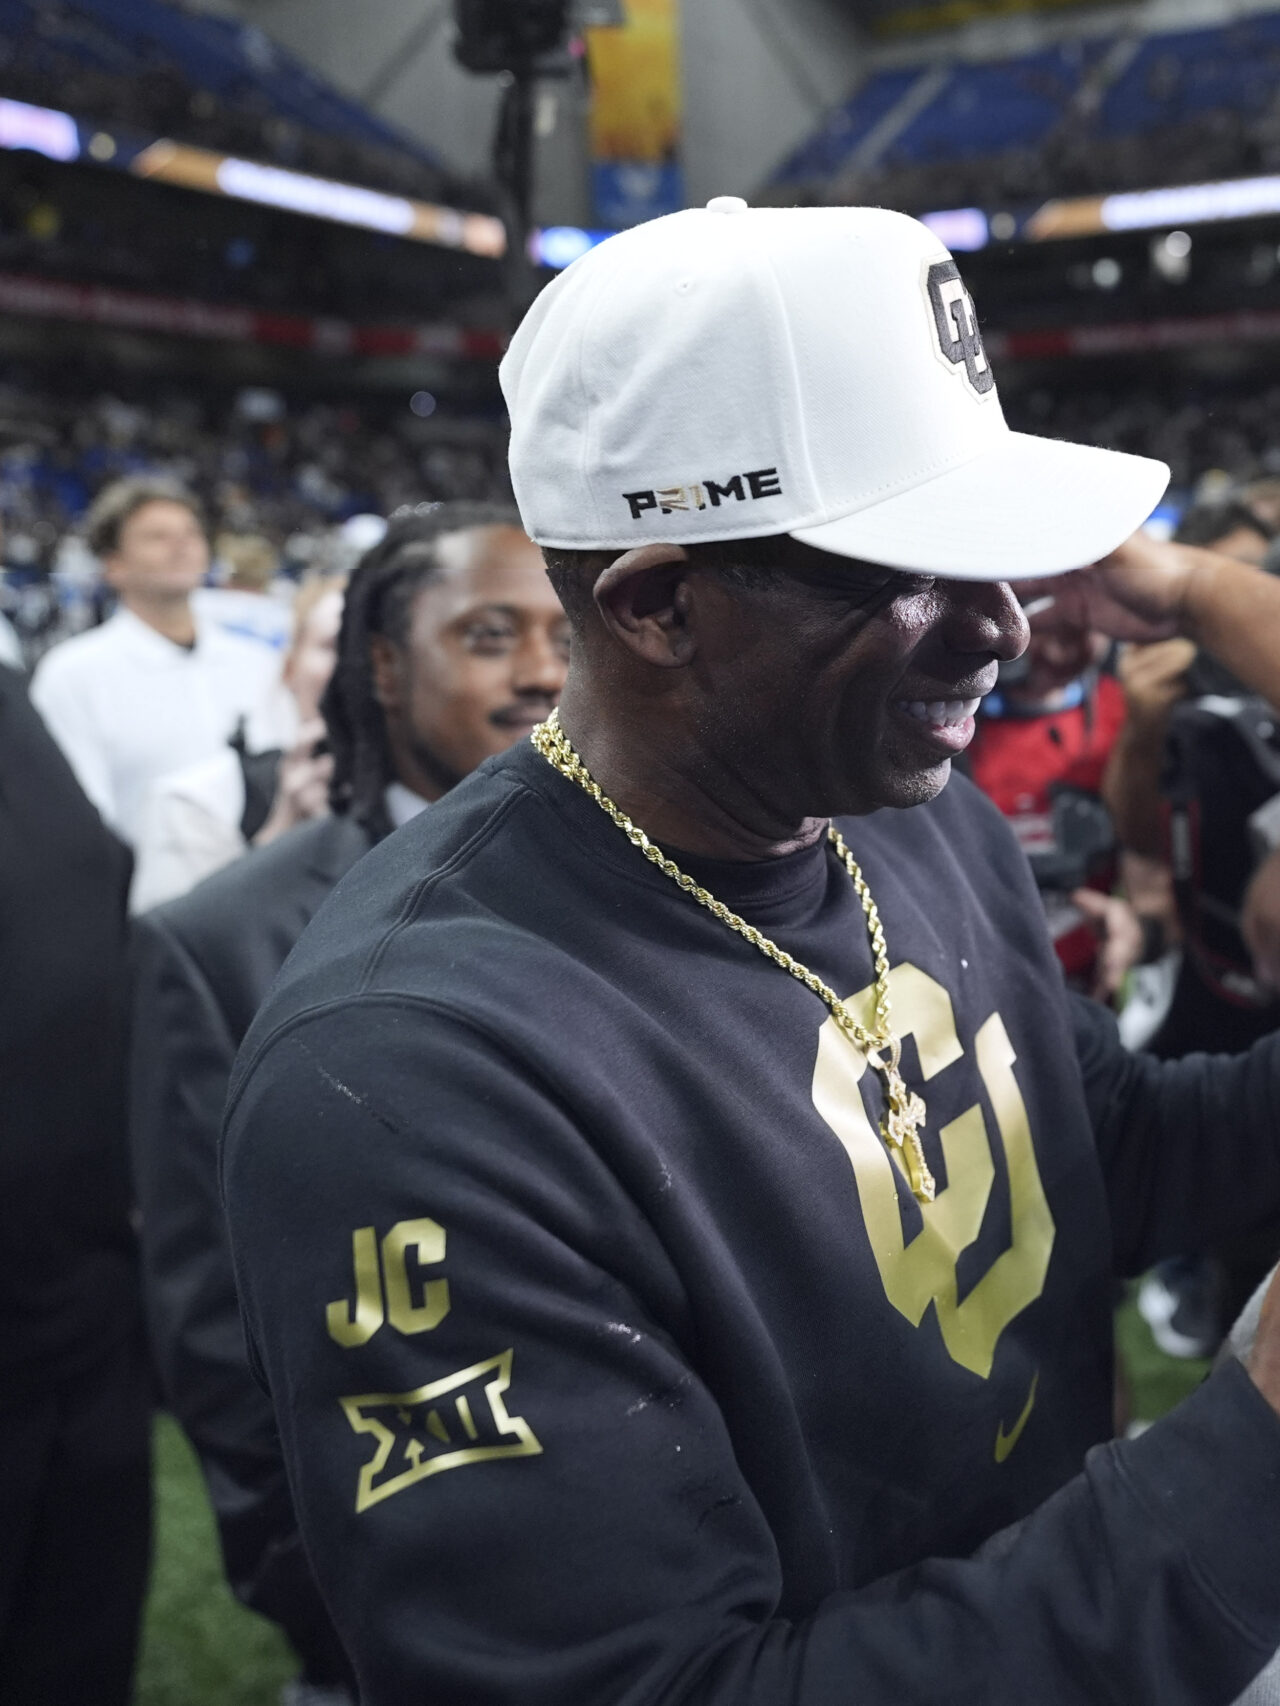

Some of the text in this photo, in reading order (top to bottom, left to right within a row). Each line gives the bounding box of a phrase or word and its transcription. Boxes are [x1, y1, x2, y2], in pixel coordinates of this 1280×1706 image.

[622, 467, 783, 520] PRIME
[812, 962, 1056, 1380] CU
[326, 1217, 450, 1349] JC
